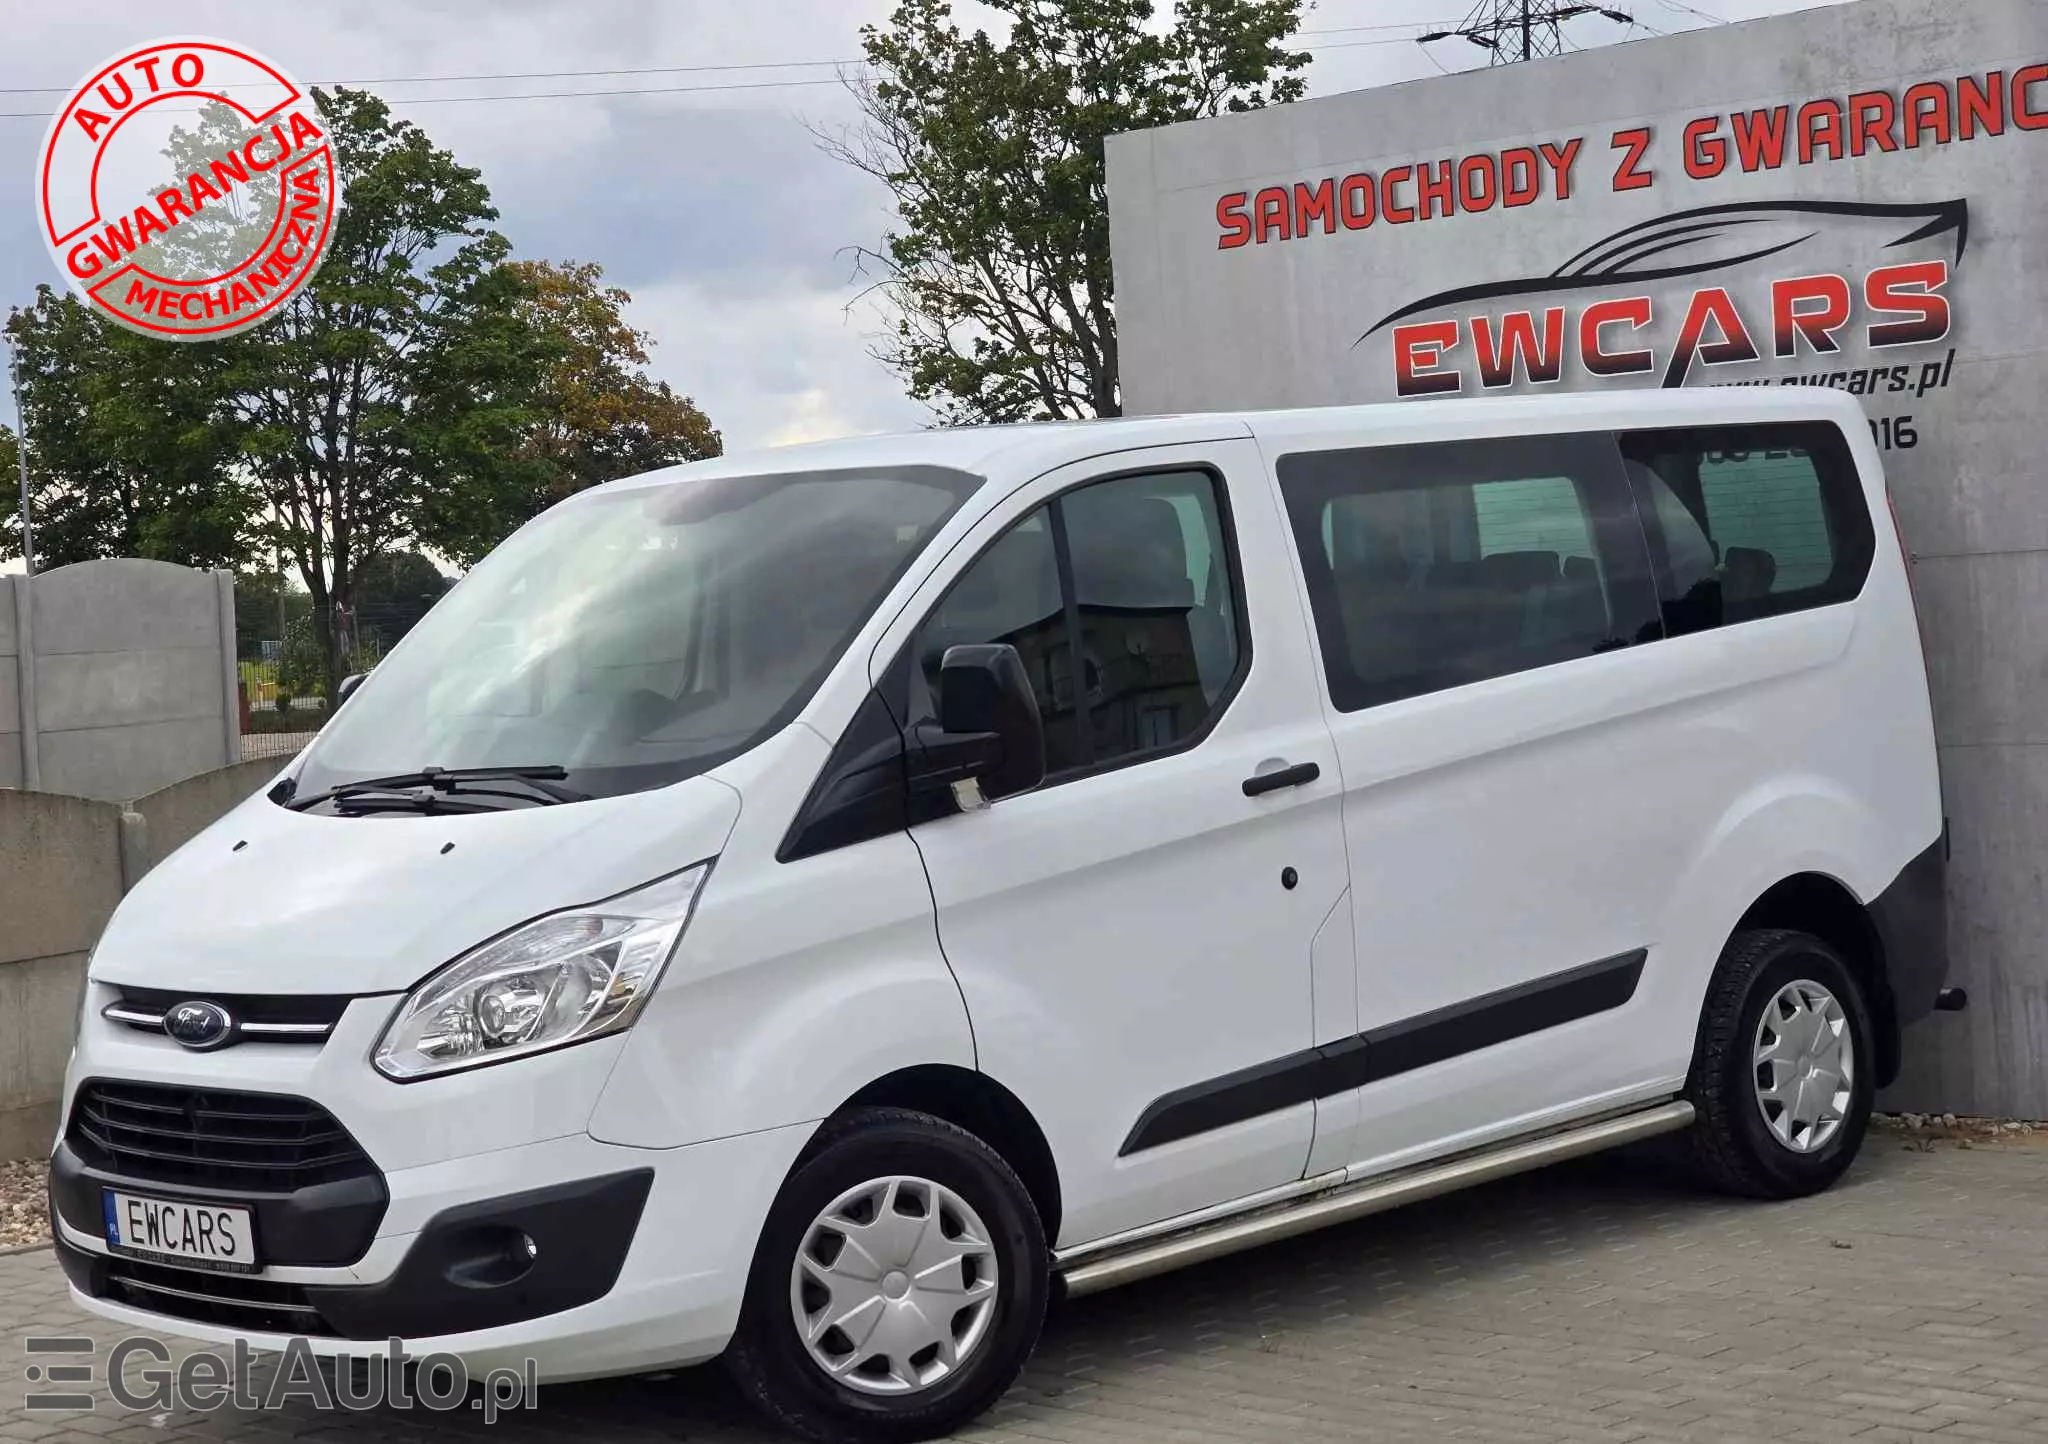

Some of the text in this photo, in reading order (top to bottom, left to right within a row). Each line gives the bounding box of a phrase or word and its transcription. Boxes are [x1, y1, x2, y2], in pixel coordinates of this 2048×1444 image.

[1216, 138, 1583, 249] SAMOCHODY
[1611, 126, 1654, 192] Z
[1393, 260, 1951, 397] EWCARS
[1709, 348, 1955, 398] wcars.pl
[1868, 415, 1918, 450] 16
[128, 1200, 236, 1256] EWCARS
